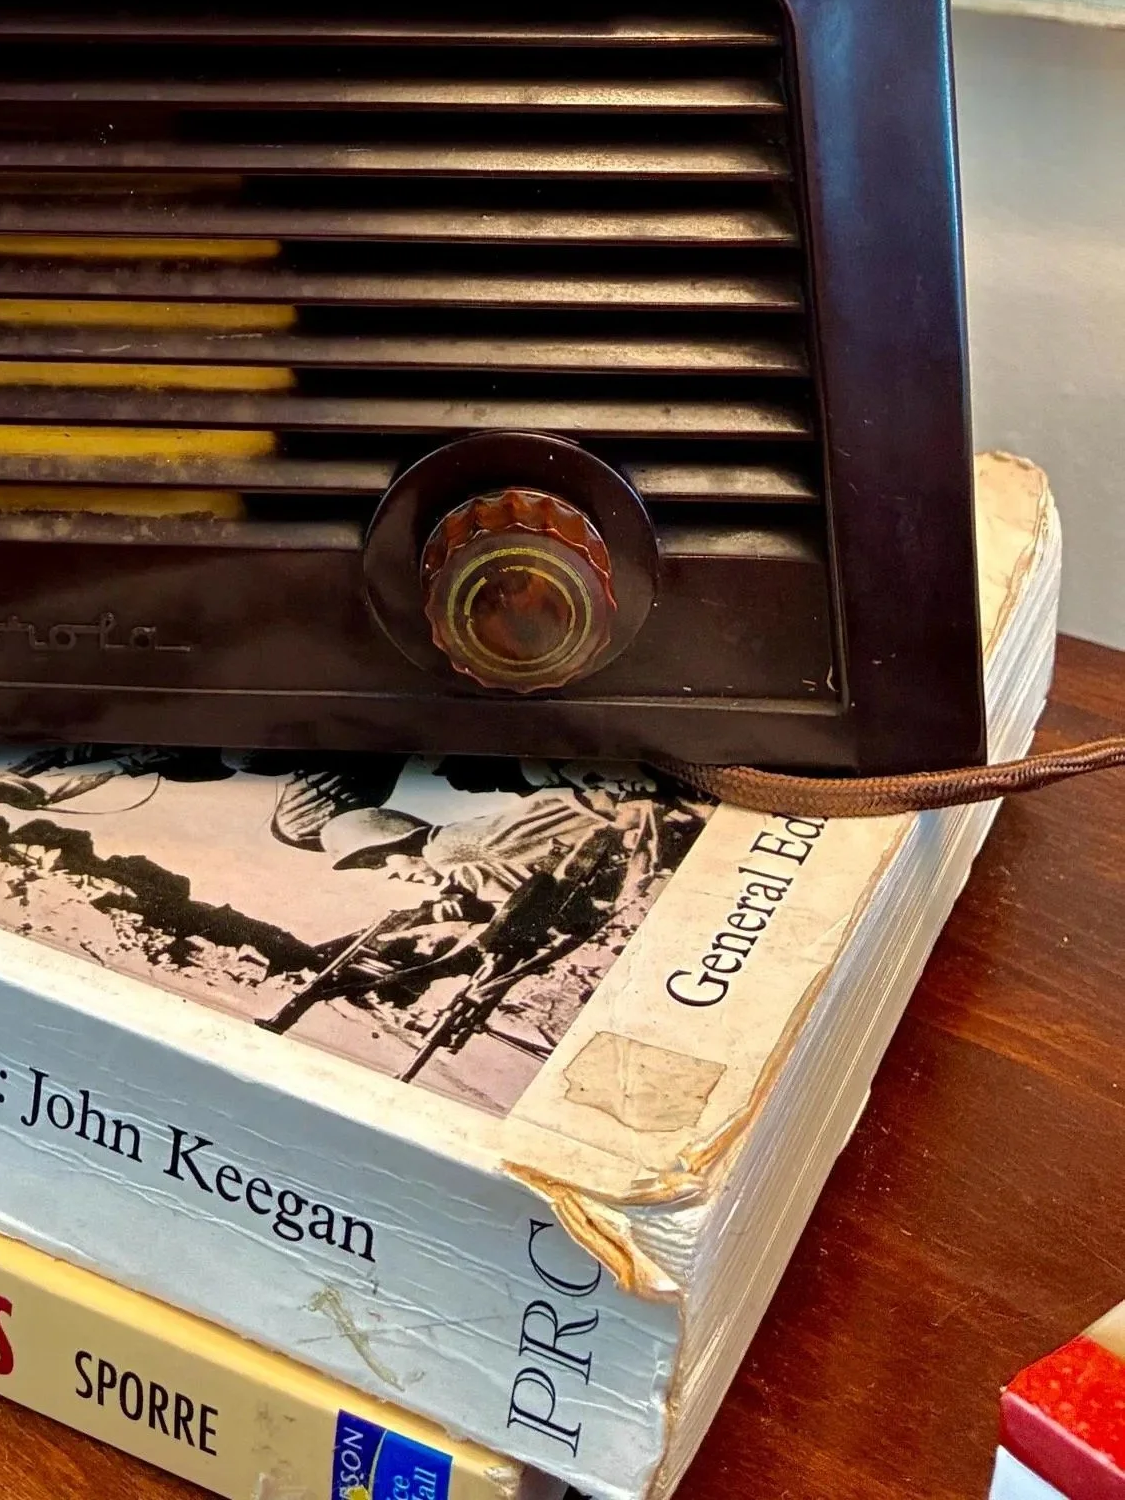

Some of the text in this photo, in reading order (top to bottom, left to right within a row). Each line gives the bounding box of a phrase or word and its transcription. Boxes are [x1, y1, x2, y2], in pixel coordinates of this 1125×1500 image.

[666, 812, 829, 1007] General Ed
[22, 1067, 143, 1164] John
[164, 1124, 377, 1263] Keegan
[75, 1349, 218, 1456] SPORRE
